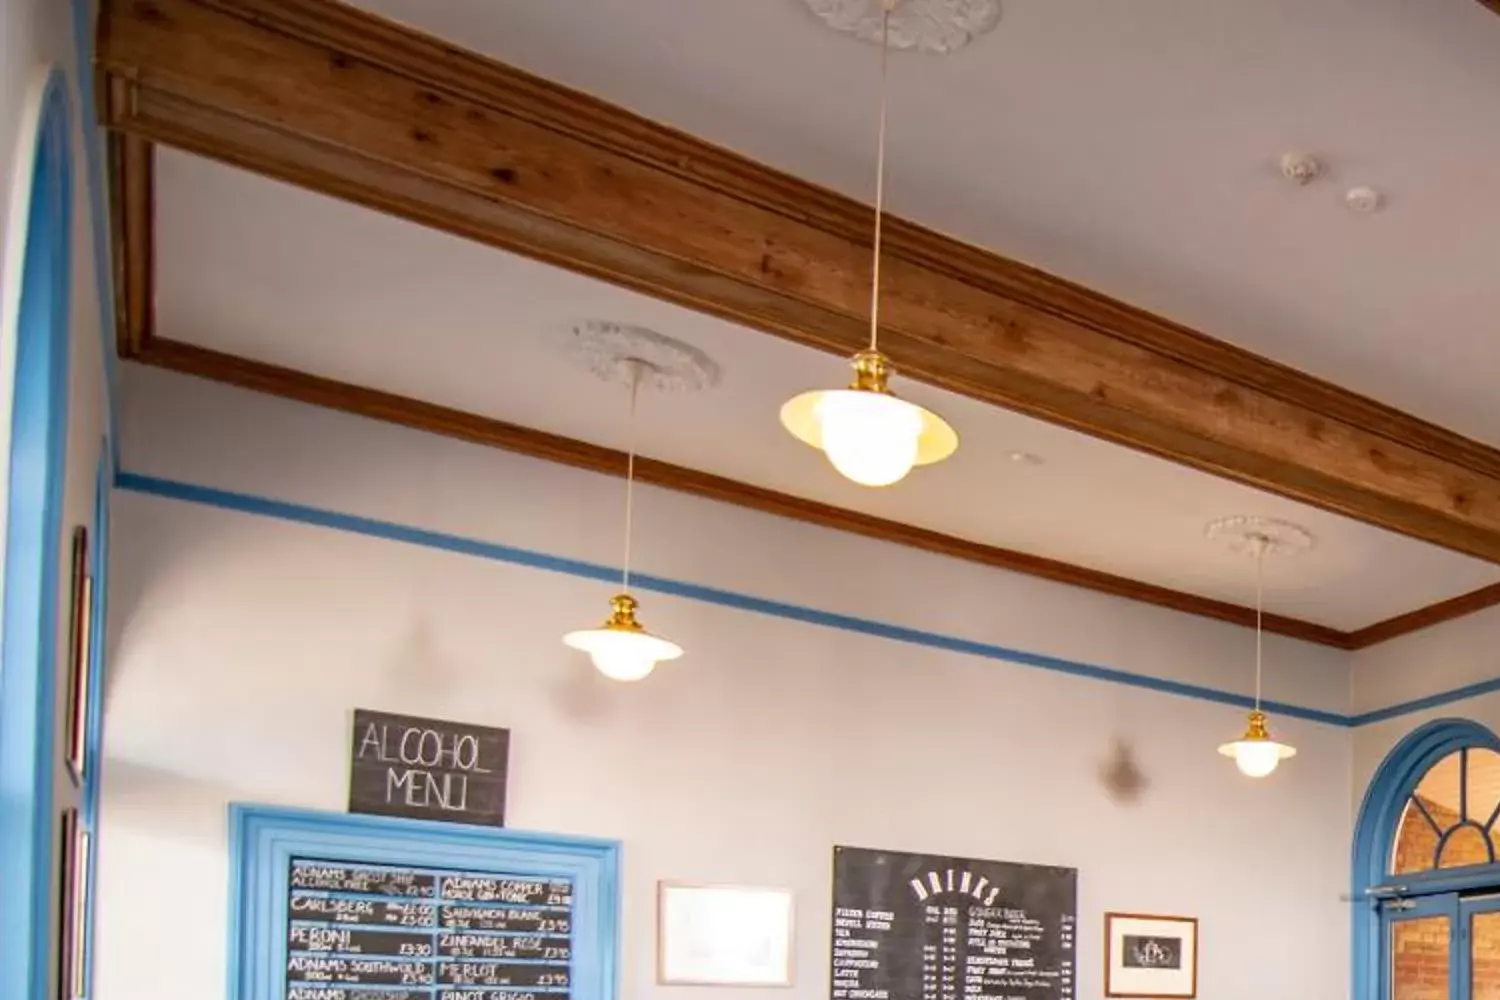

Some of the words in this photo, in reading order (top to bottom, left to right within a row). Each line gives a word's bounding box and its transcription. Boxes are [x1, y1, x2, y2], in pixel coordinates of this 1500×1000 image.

[358, 721, 492, 773] ALCOHOL
[386, 767, 468, 810] MENU
[291, 896, 375, 916] CARLSBERG
[910, 868, 1000, 907] DRINKS
[290, 926, 351, 943] PERONI
